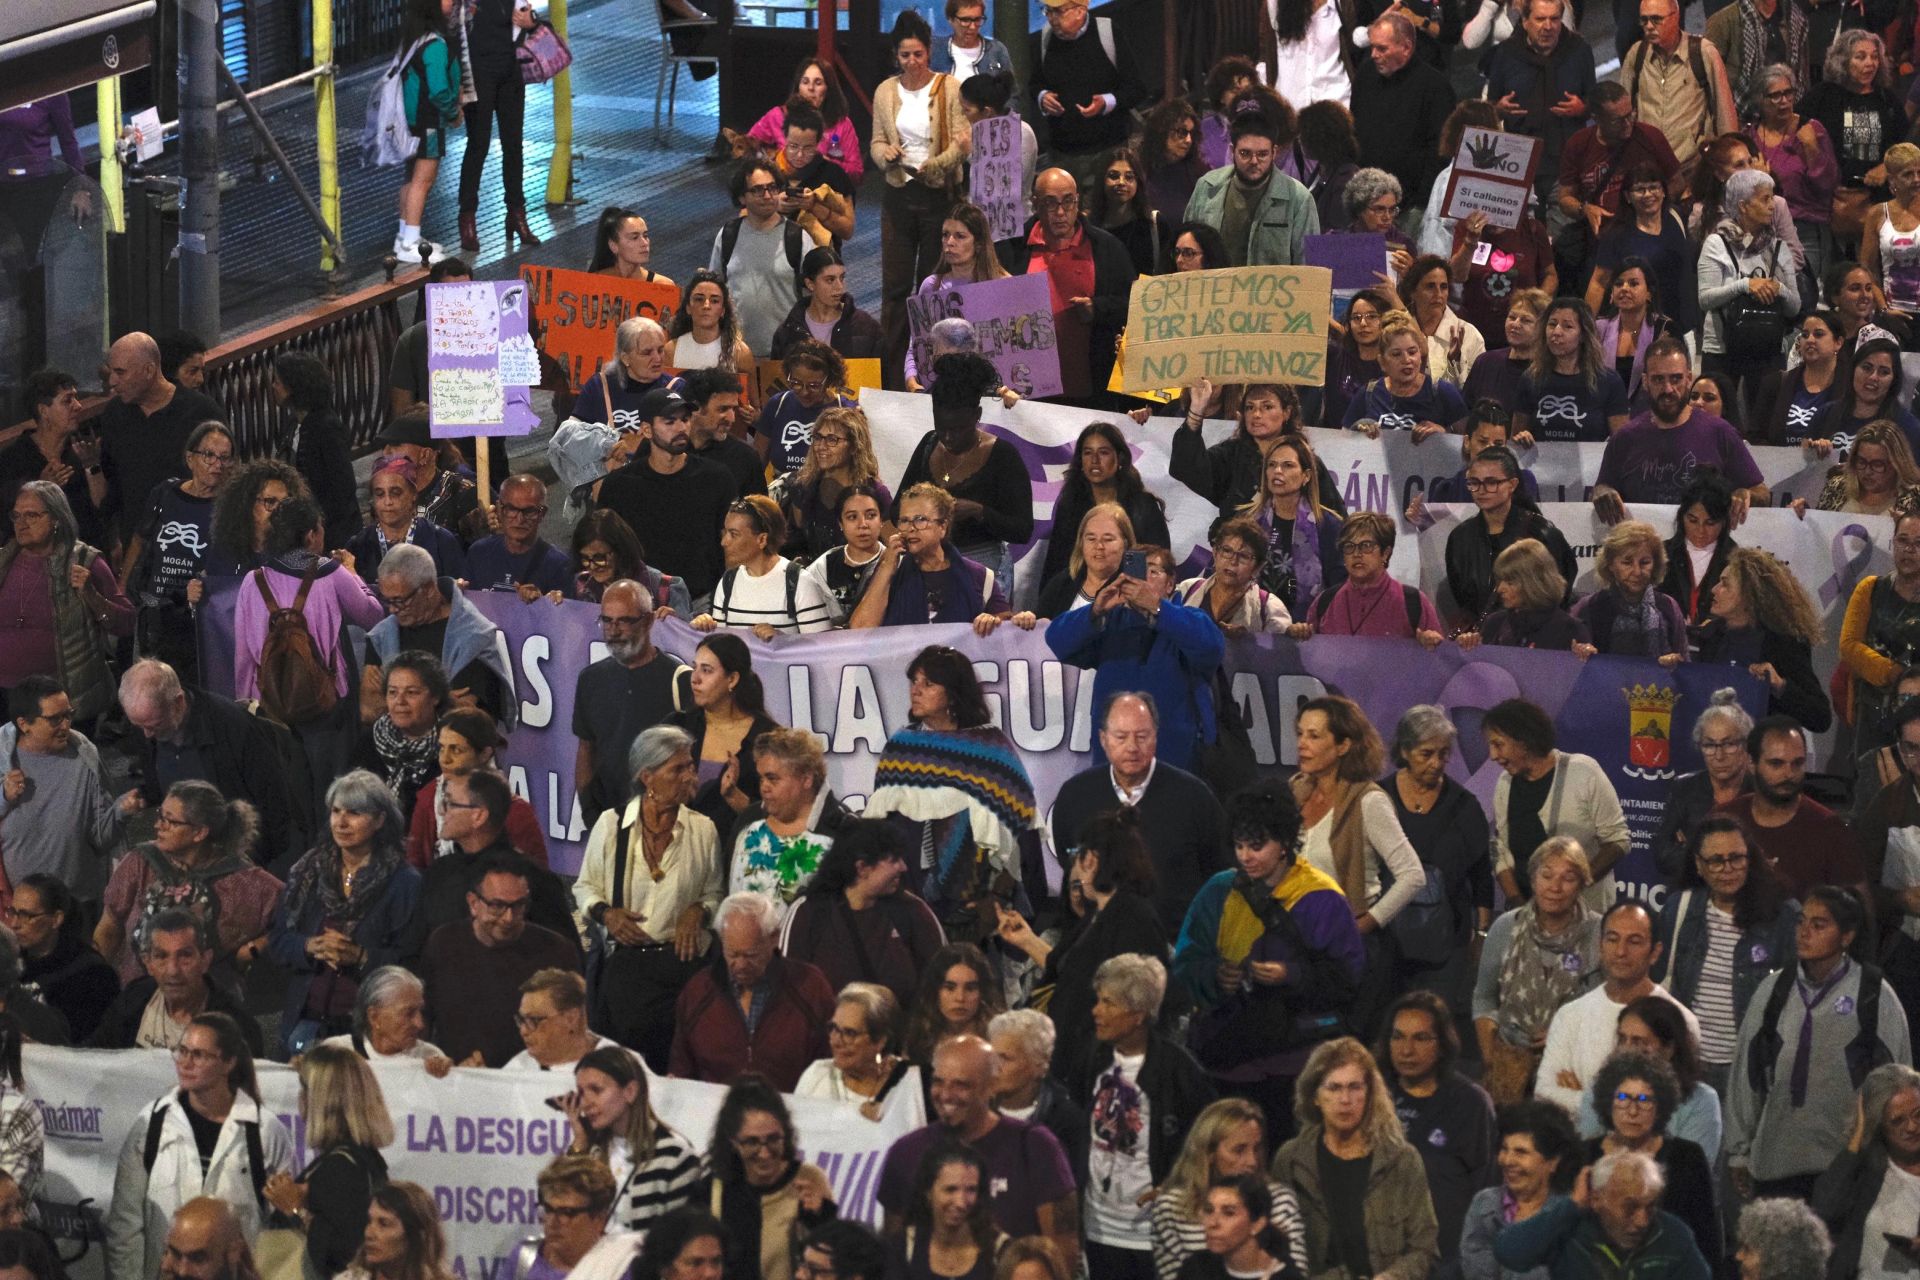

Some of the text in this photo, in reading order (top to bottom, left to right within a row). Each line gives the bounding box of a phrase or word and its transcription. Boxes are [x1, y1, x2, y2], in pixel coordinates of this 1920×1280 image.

[1494, 160, 1520, 174] NO
[1460, 187, 1519, 207] Si callamos
[1460, 200, 1513, 217] nos matan
[523, 267, 553, 305] NI
[1141, 273, 1301, 313] GRITEMOS
[1142, 308, 1314, 342] POR LAS QUE YA
[1141, 352, 1188, 382] NO
[162, 555, 194, 568] MOGÁN
[788, 663, 889, 754] LA
[407, 1114, 572, 1156] LA DESIGU
